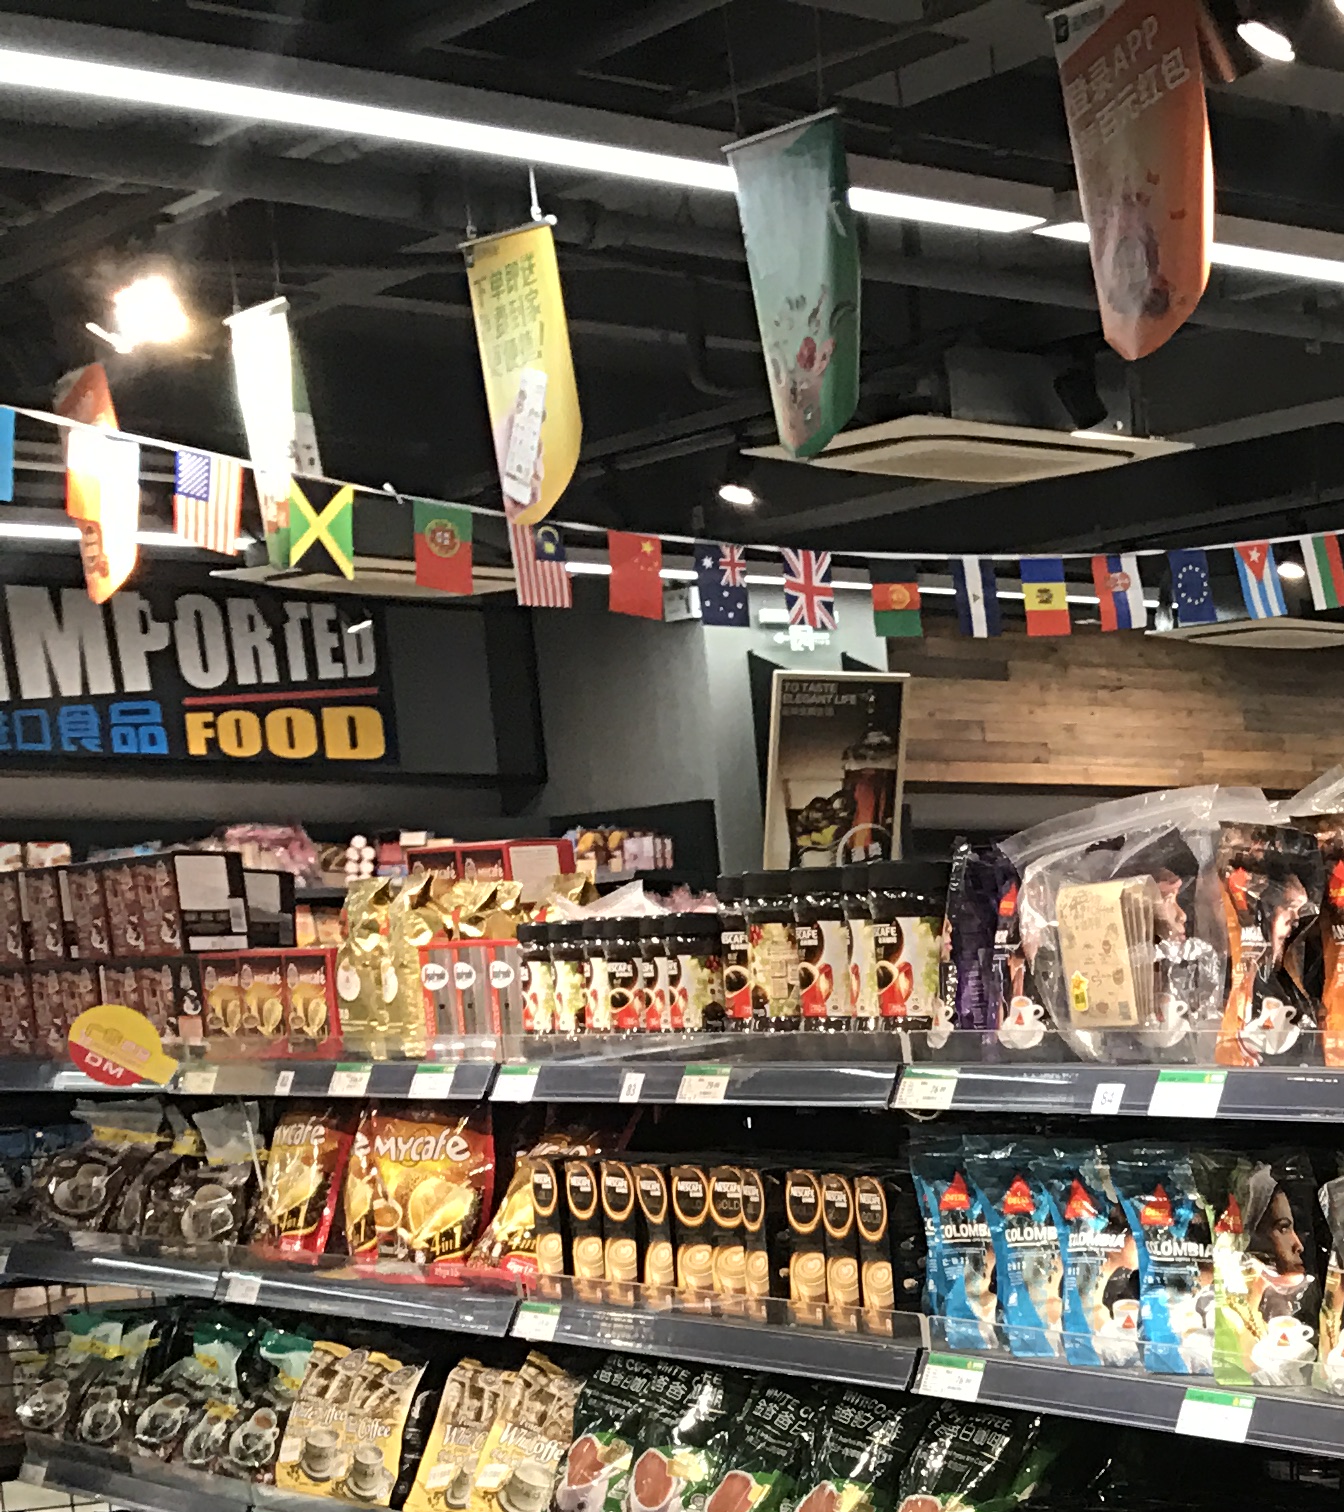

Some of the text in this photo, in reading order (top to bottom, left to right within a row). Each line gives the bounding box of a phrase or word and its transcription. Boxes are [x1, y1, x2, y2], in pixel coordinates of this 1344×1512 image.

[0, 585, 375, 700] MPORTED
[185, 706, 385, 759] FOOD
[84, 1052, 126, 1080] DM
